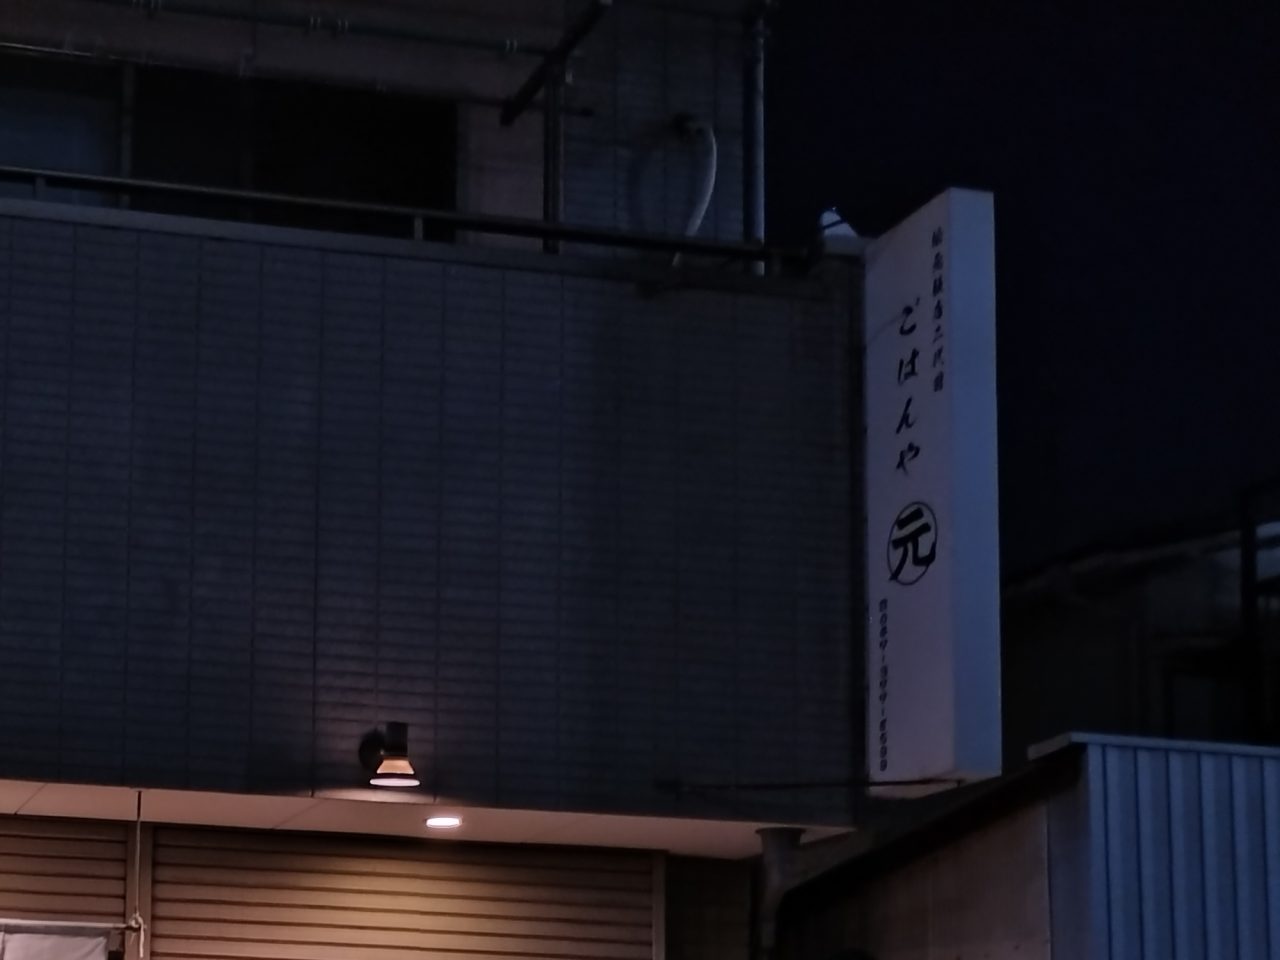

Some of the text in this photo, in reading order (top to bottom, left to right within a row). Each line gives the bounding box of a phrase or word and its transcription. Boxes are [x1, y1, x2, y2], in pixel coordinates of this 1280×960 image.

[895, 297, 920, 475] ごはんや
[888, 502, 938, 585] 元
